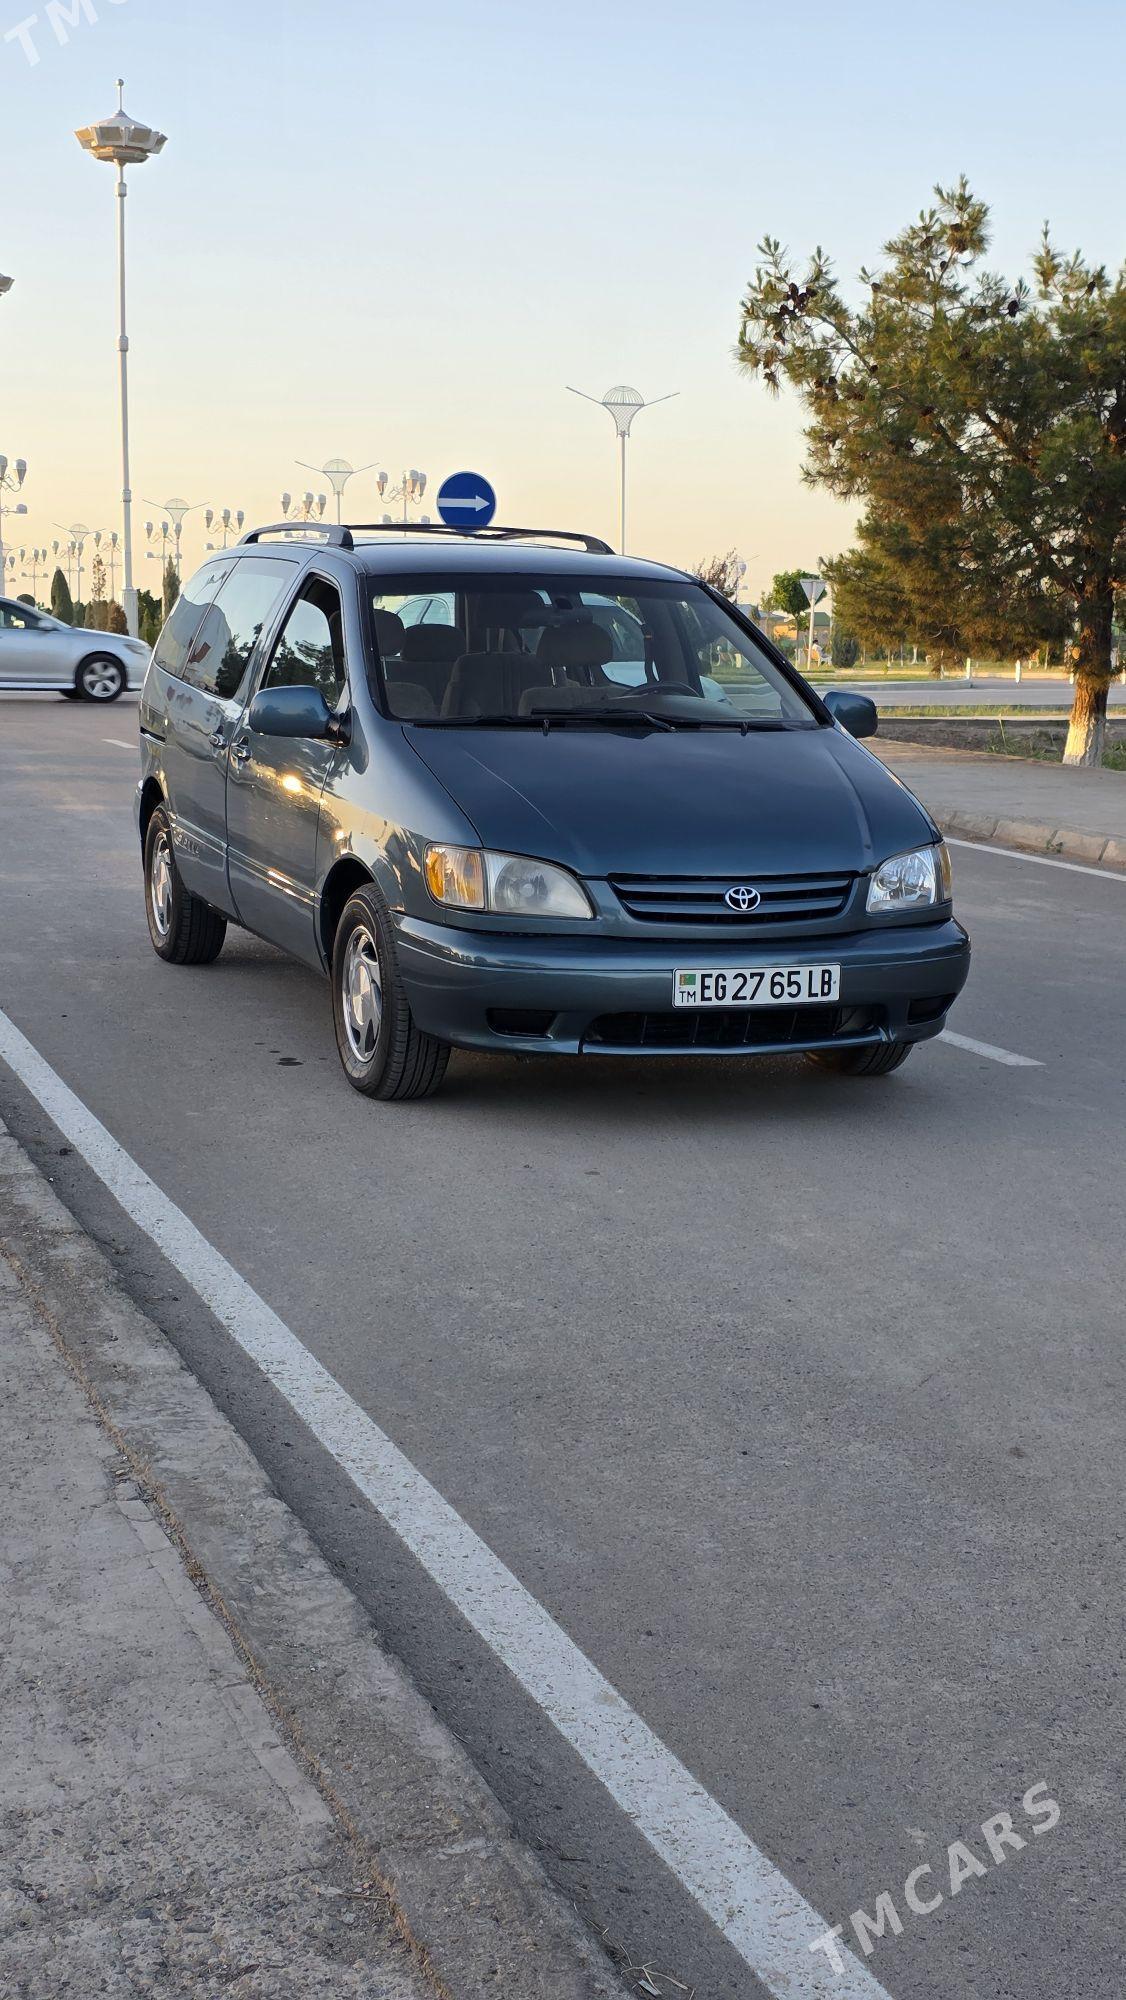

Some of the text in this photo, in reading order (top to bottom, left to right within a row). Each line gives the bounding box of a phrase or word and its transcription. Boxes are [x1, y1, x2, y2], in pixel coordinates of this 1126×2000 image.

[701, 969, 832, 1001] EG 27 65 LB
[679, 991, 696, 1003] TM
